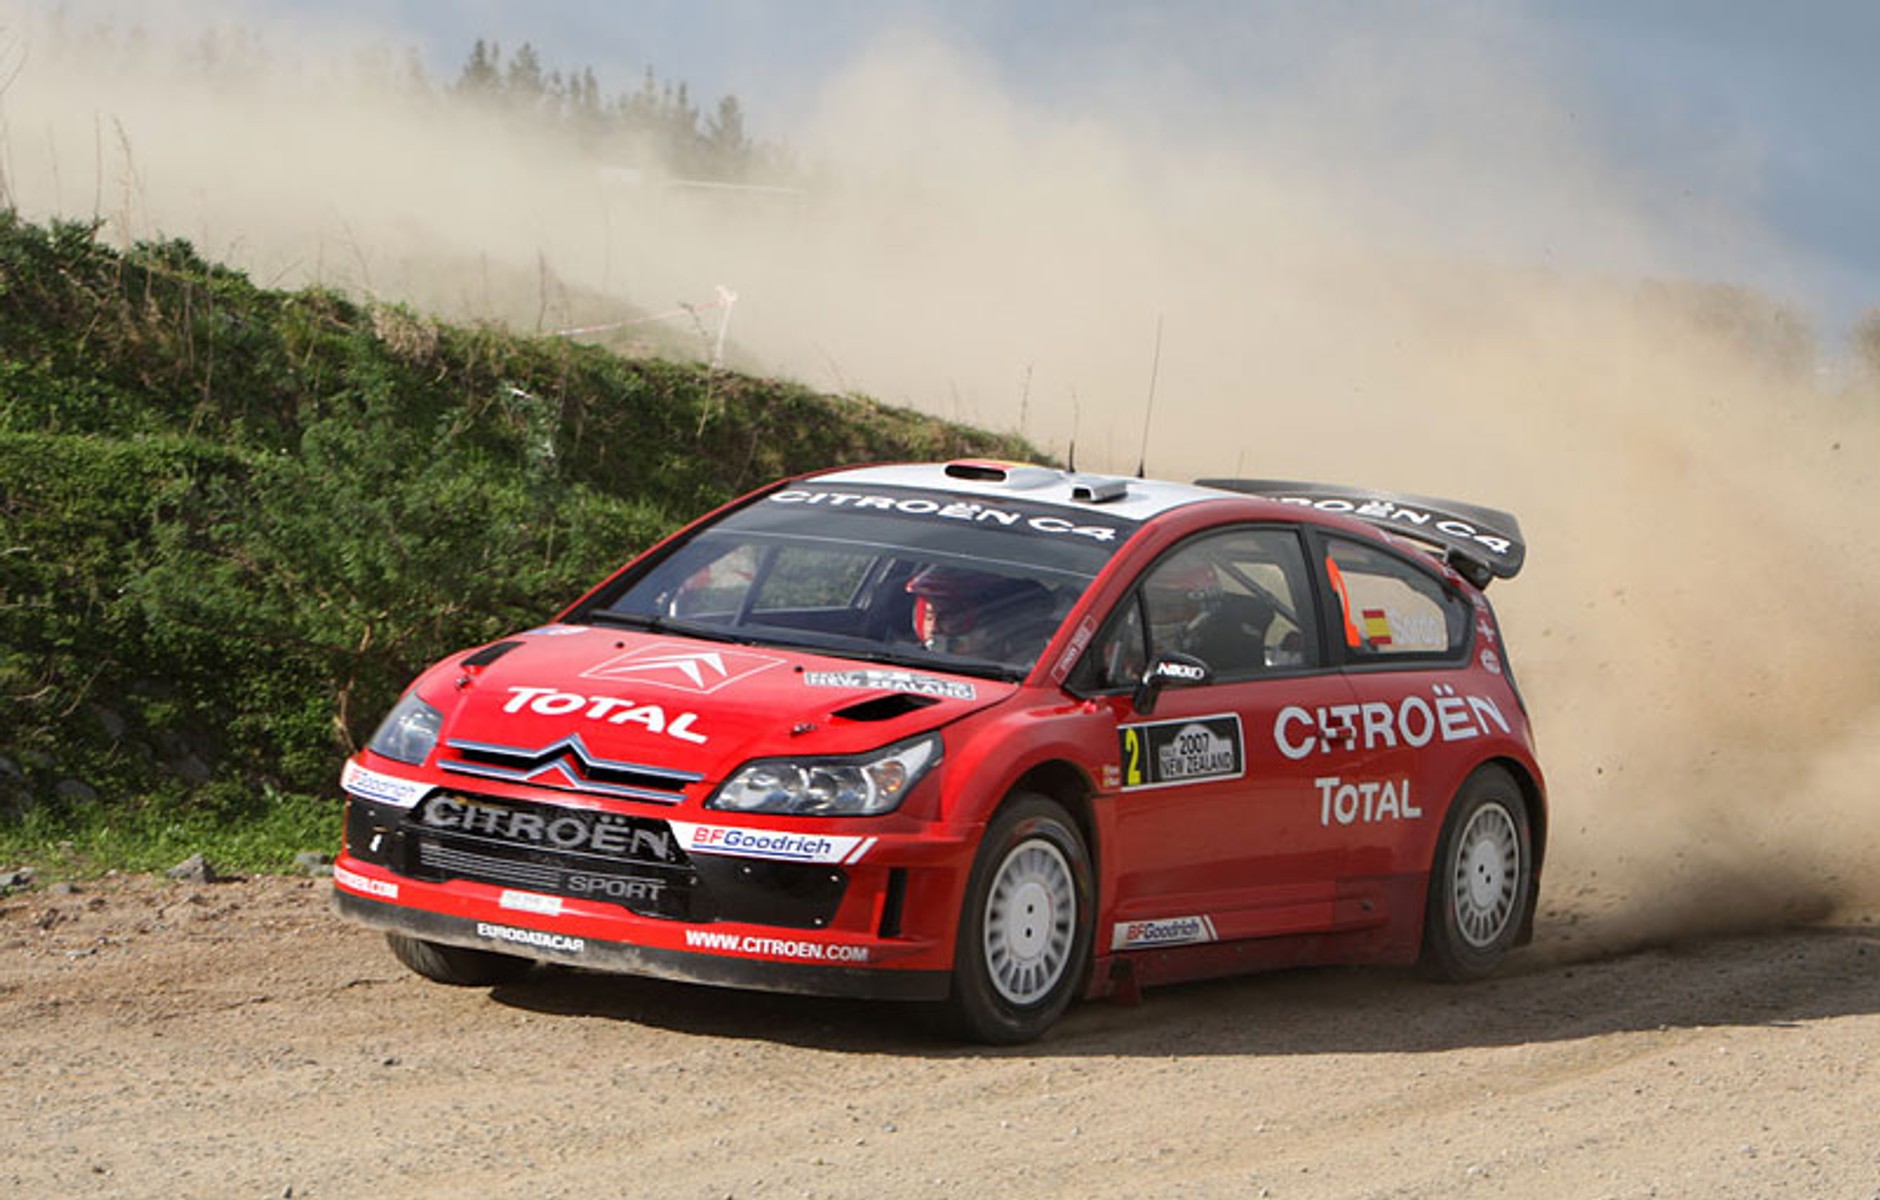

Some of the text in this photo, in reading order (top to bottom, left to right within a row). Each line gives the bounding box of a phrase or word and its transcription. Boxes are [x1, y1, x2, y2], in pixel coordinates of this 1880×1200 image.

[769, 490, 1115, 541] CITROËN C4
[1435, 521, 1512, 554] C4
[1273, 684, 1511, 760] CITROËN
[1125, 727, 1141, 786] 2
[1180, 732, 1209, 755] 2007
[1186, 751, 1230, 774] ZEALAND
[423, 795, 671, 862] CITROËN
[692, 826, 832, 855] BFGoodrich
[568, 875, 667, 901] SPORT
[685, 929, 869, 961] WWW.CITROEN.COM
[1126, 919, 1200, 940] BFGoodrich
